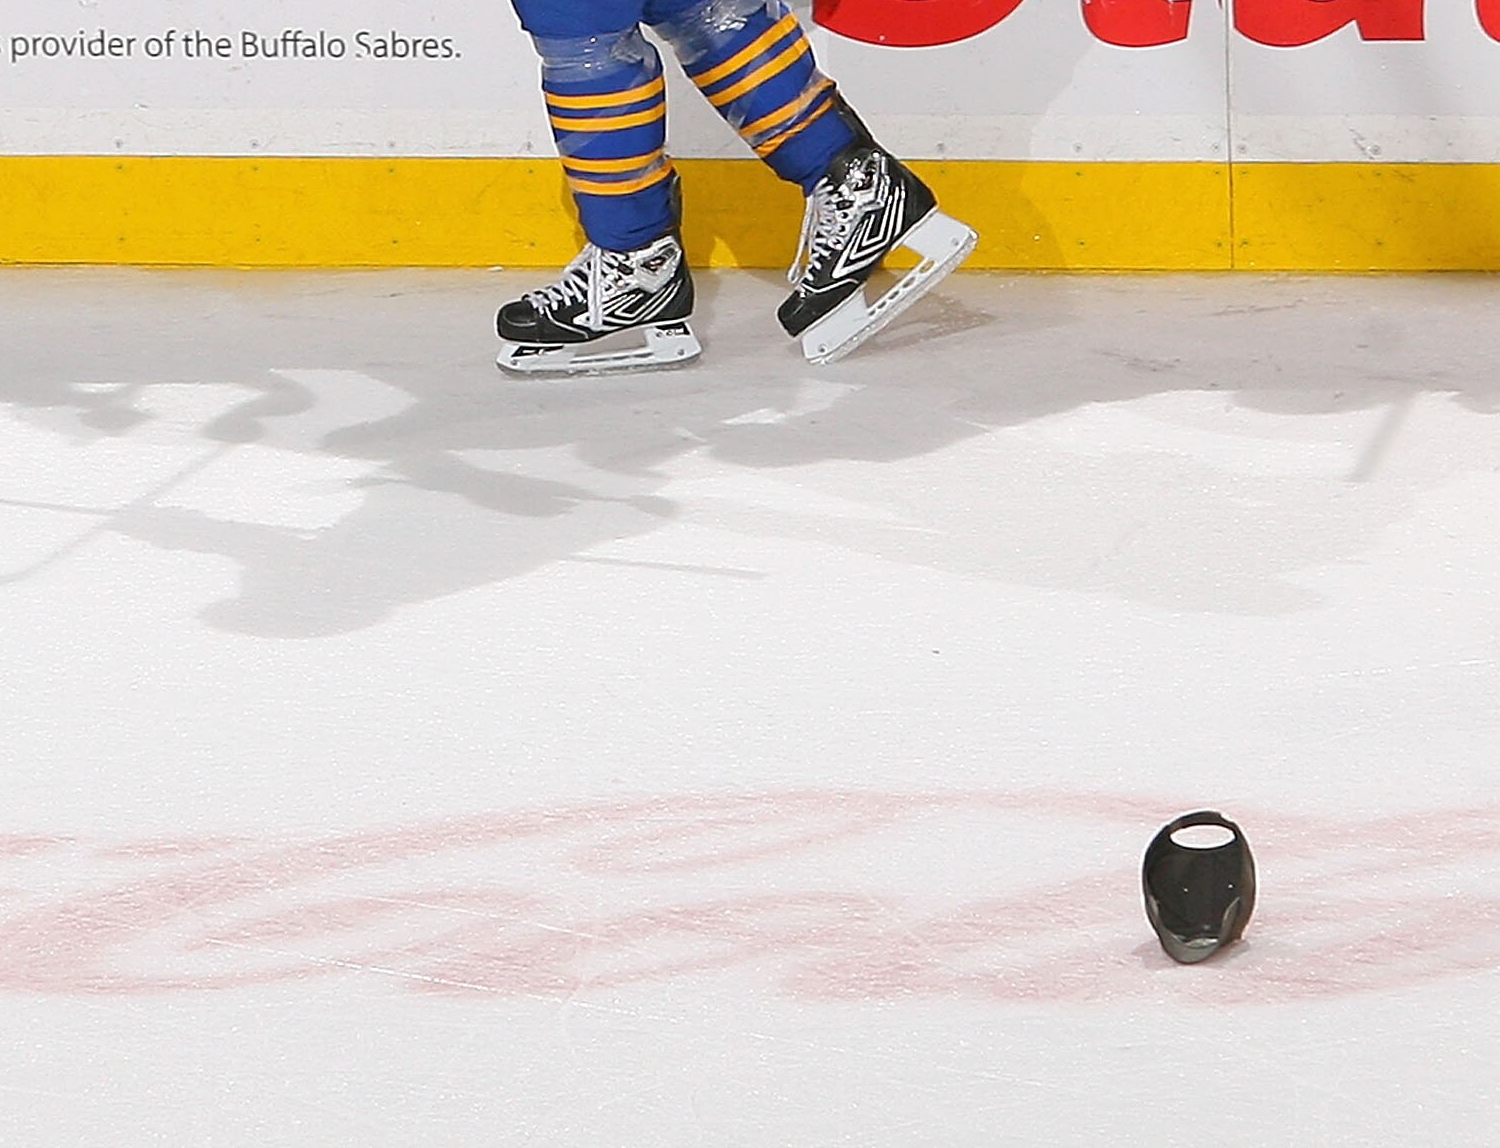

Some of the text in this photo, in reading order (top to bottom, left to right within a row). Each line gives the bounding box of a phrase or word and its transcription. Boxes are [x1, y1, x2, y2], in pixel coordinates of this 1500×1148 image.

[11, 29, 137, 63] provider
[144, 30, 177, 58] of
[182, 30, 232, 58] the
[241, 31, 346, 58] Buffalo
[354, 31, 462, 59] Sabres.
